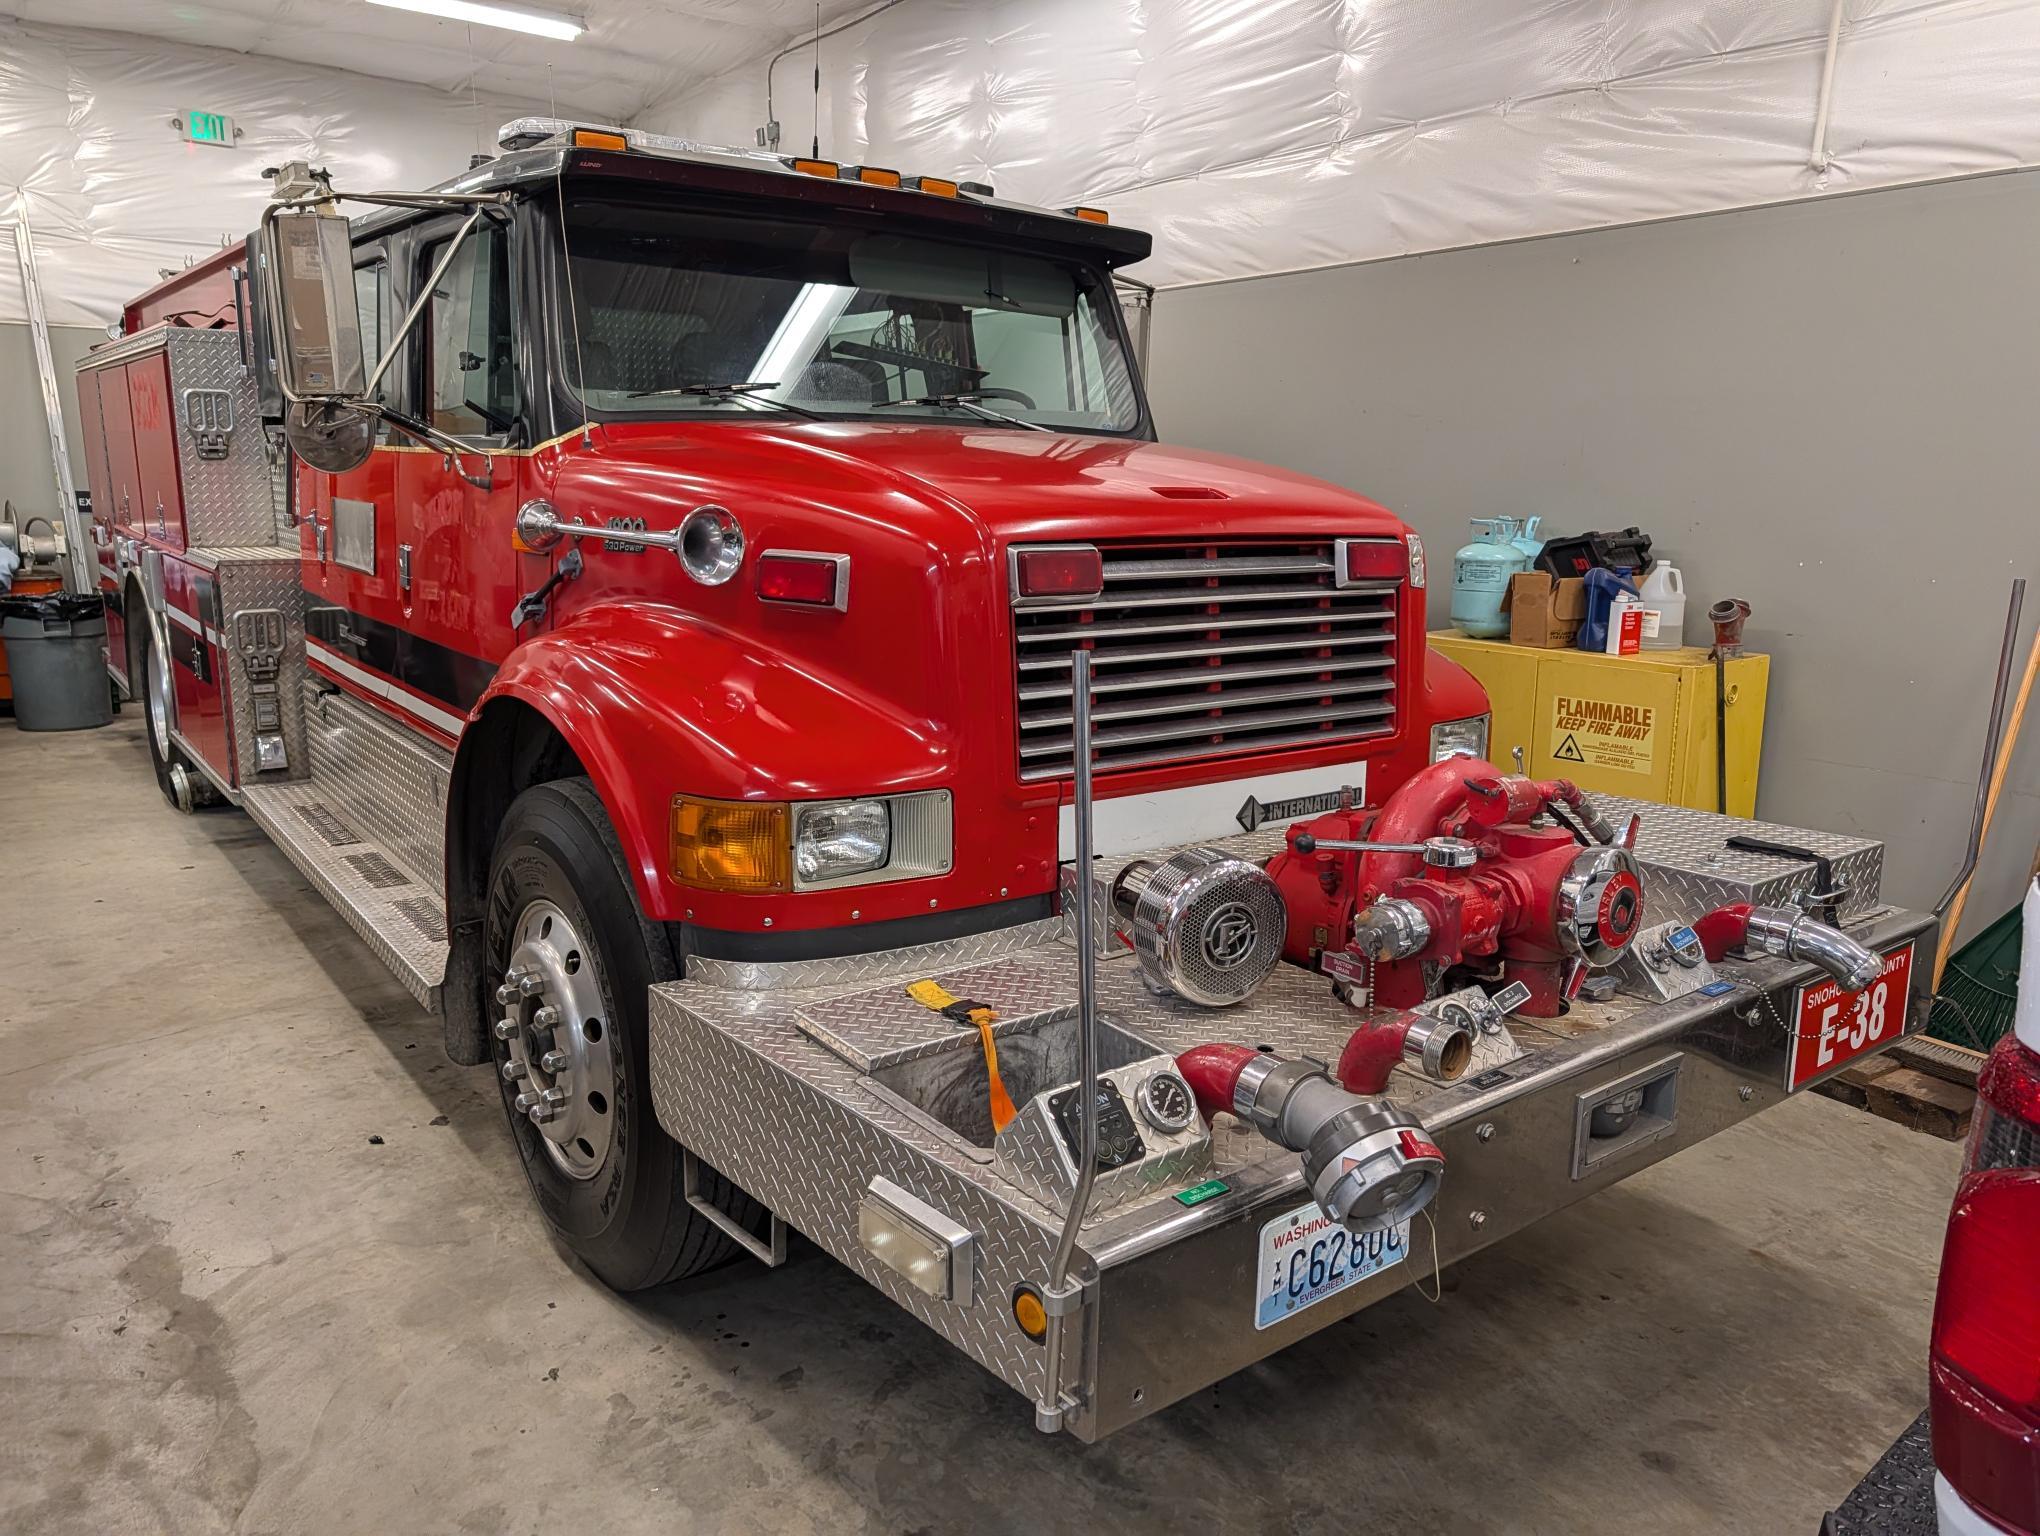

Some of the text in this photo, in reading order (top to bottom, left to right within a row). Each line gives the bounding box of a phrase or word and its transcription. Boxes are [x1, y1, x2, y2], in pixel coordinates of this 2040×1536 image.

[190, 111, 226, 141] EXIT
[79, 497, 92, 506] EX
[1557, 697, 1652, 727] FLAMMABLE
[1556, 716, 1650, 741] KEEP FIRE AWAY
[1600, 875, 1622, 924] DARLEY
[1817, 982, 1888, 1067] E-38
[1299, 1263, 1372, 1304] EVERGREEN STATE
